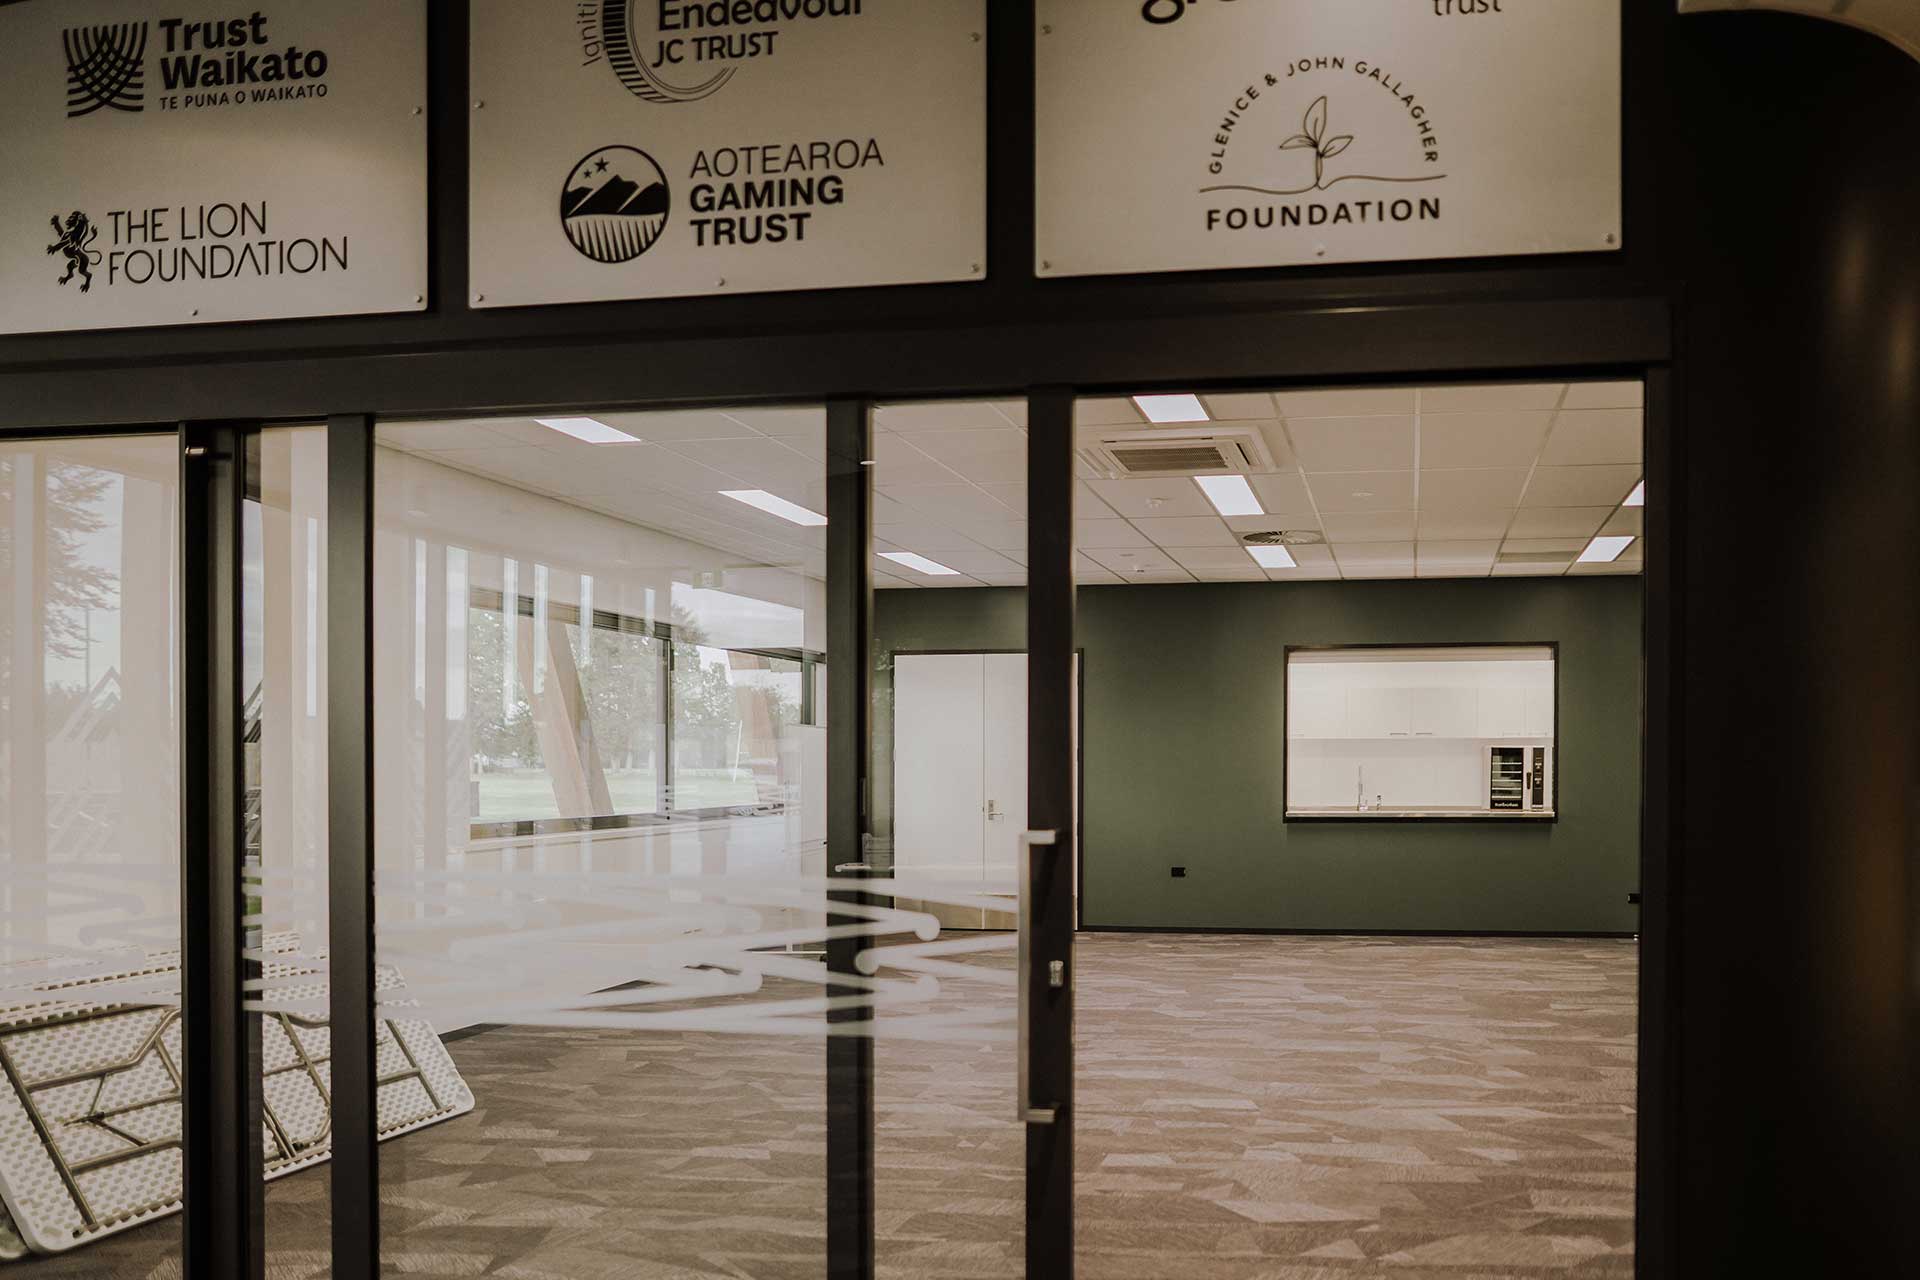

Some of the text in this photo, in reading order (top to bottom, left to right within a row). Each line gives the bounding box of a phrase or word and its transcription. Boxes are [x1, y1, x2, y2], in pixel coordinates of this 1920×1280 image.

[158, 11, 268, 53] Trust
[651, 30, 779, 68] JC TRUST
[159, 46, 329, 91] Waikato
[159, 82, 329, 111] TE PUNA O WAIKATO
[1208, 56, 1439, 176] GLENICE & JOHN GALLAGHER
[689, 137, 885, 179] AOTEAROA
[689, 174, 845, 214] GAMING
[1205, 197, 1442, 232] FOUNDATION
[106, 200, 267, 246] THE LION
[689, 211, 812, 247] TRUST
[108, 235, 349, 286] FOUNDATION
